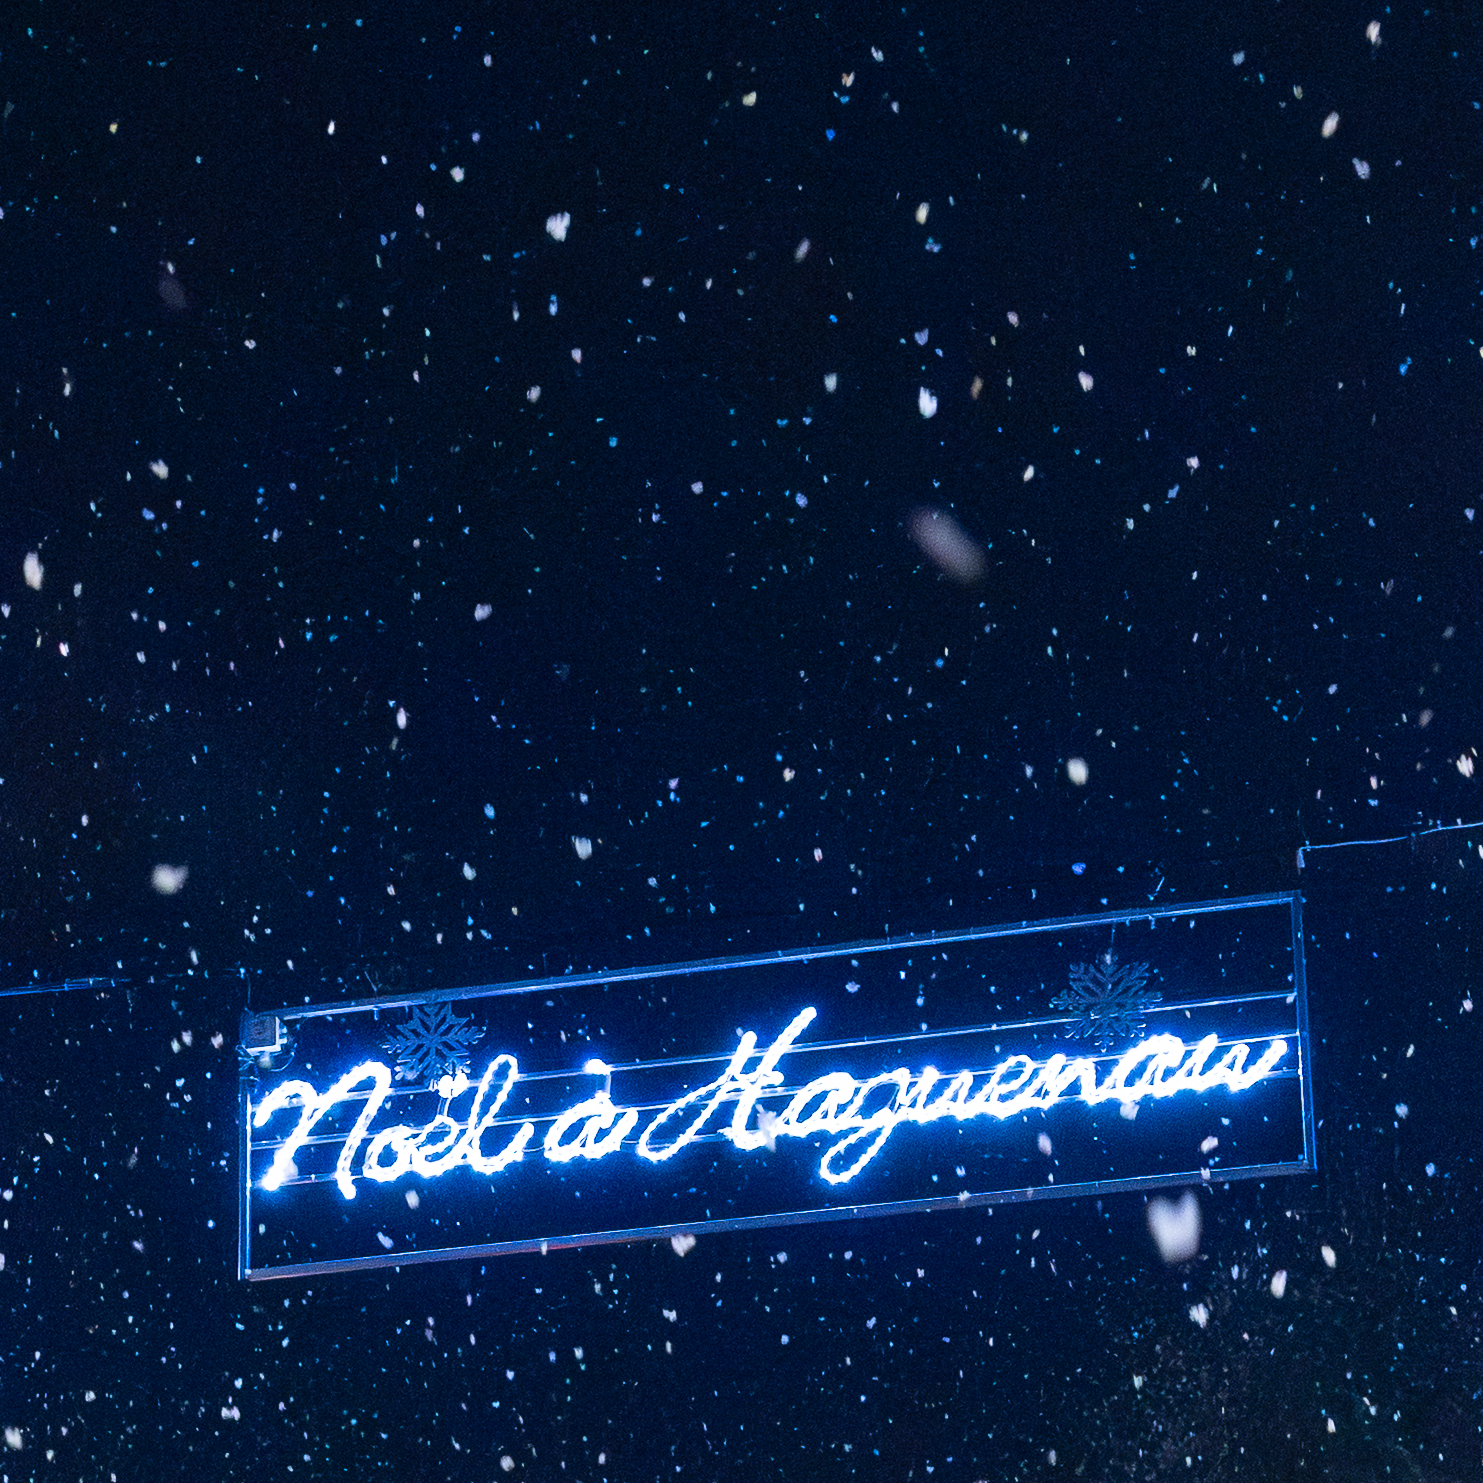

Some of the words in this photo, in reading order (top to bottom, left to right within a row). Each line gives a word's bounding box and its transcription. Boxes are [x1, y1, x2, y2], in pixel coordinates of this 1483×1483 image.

[254, 1055, 535, 1200] Noël
[544, 1057, 640, 1163] à
[639, 1004, 1289, 1185] Haguenau
